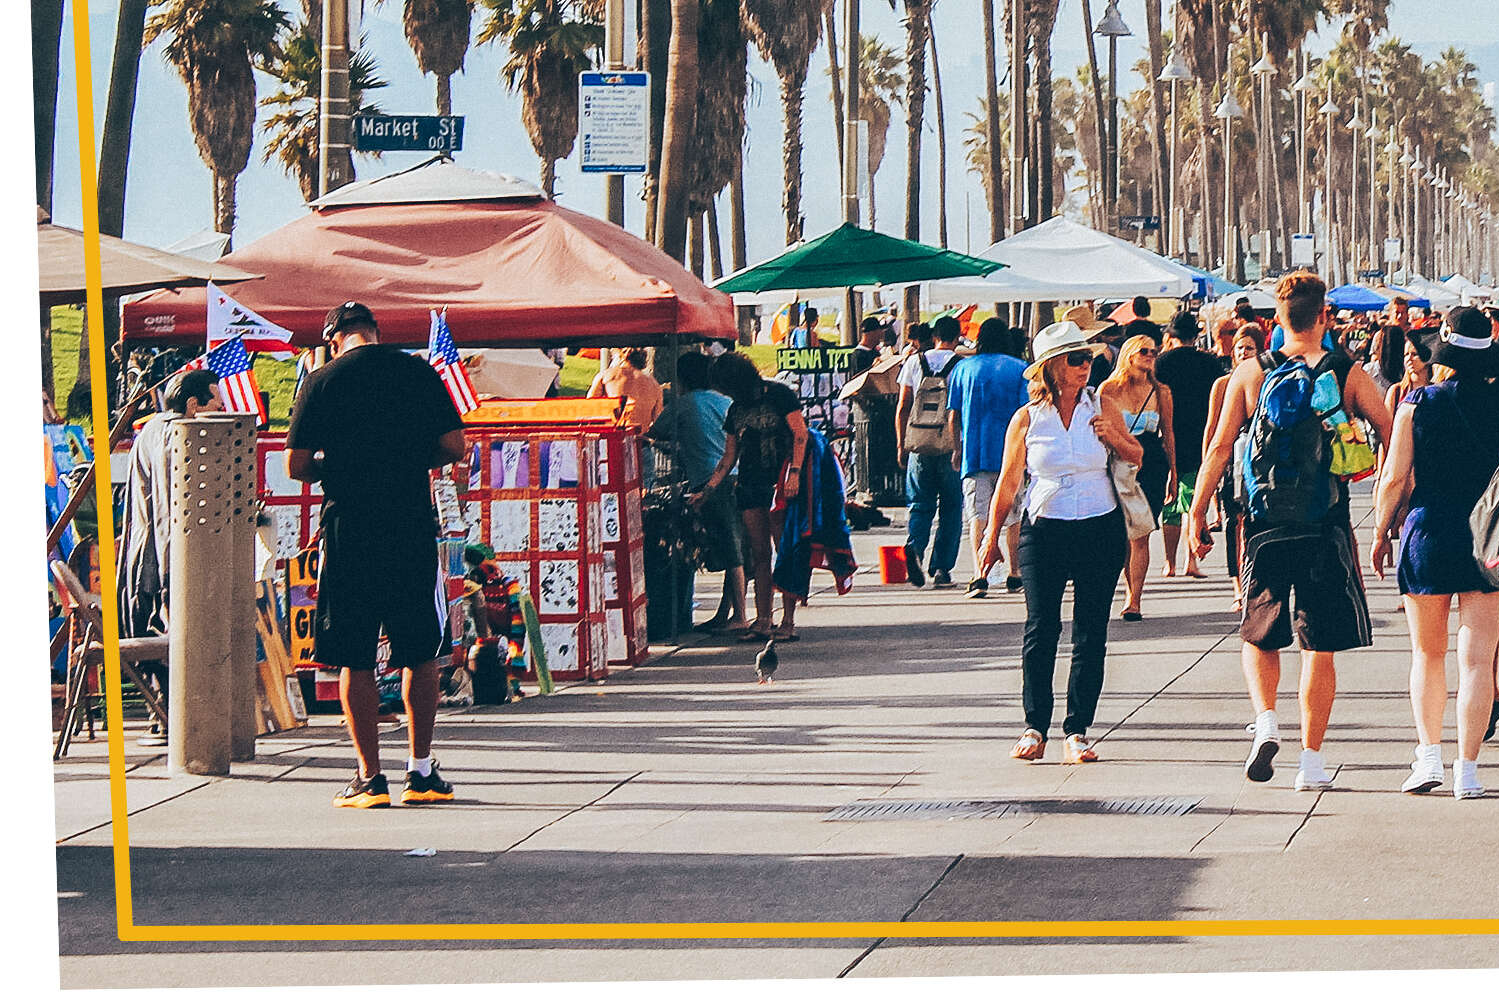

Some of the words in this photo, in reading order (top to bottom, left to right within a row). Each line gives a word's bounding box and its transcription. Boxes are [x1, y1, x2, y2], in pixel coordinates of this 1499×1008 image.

[361, 118, 419, 136] Market
[439, 118, 456, 136] St
[428, 136, 445, 149] 00
[450, 137, 457, 148] E
[777, 349, 822, 369] HENNA
